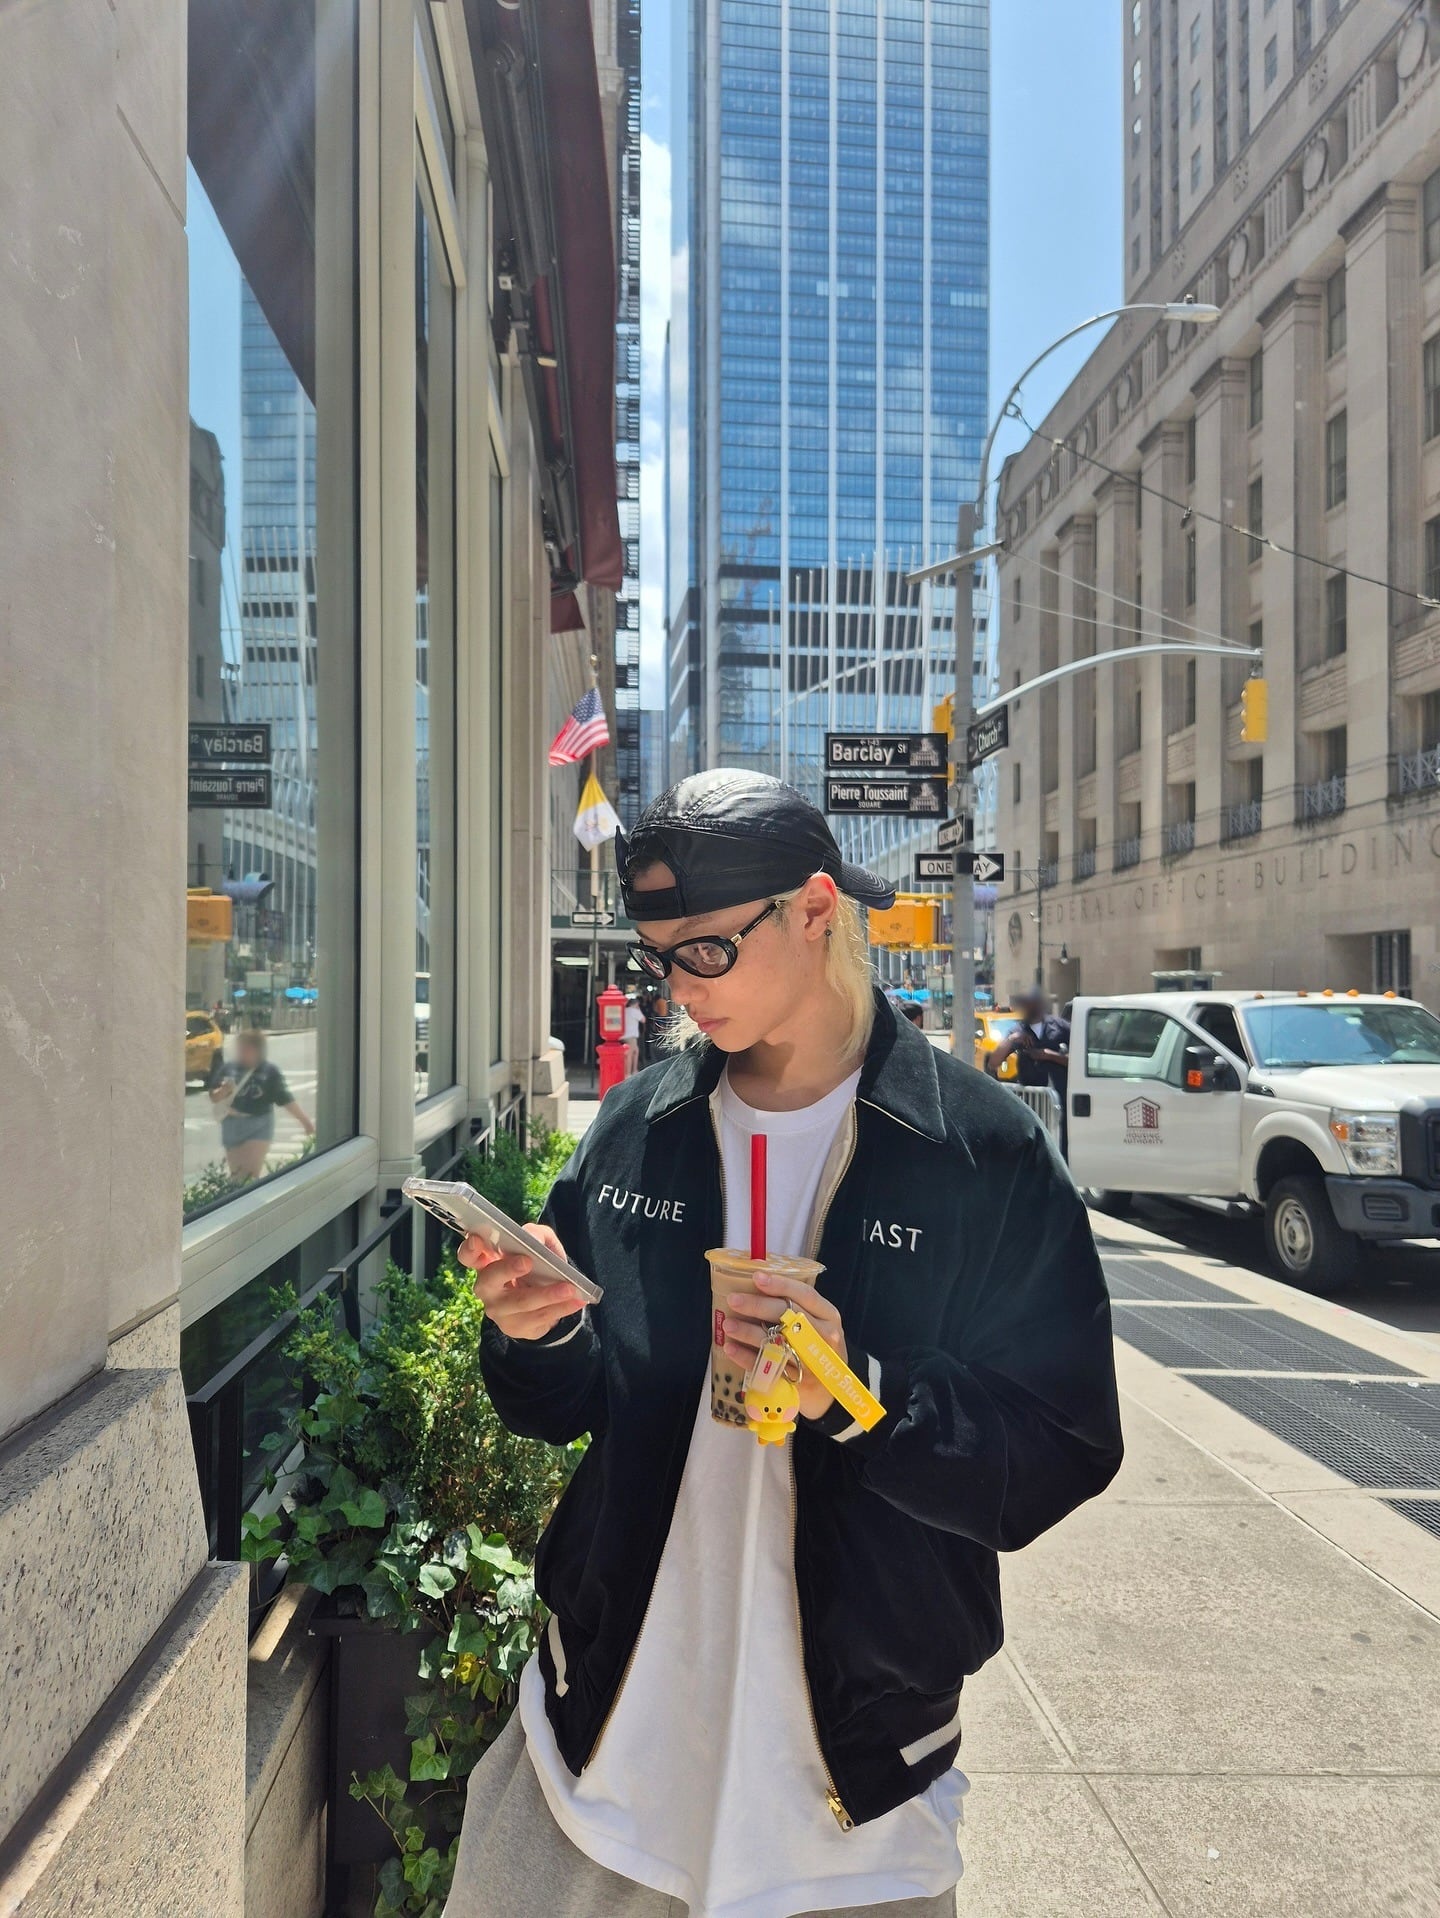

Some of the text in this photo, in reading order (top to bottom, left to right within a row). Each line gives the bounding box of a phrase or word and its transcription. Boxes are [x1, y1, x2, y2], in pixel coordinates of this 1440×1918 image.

[978, 727, 998, 752] Church
[832, 742, 907, 765] Barclay St
[831, 784, 908, 801] Pierre Toussaint
[858, 801, 881, 809] SQUARE
[927, 862, 991, 873] ONE AY
[1046, 893, 1115, 925] EDERAL
[1134, 869, 1226, 910] OFFICE
[597, 1184, 686, 1223] FUTURE
[818, 1353, 842, 1379] cha
